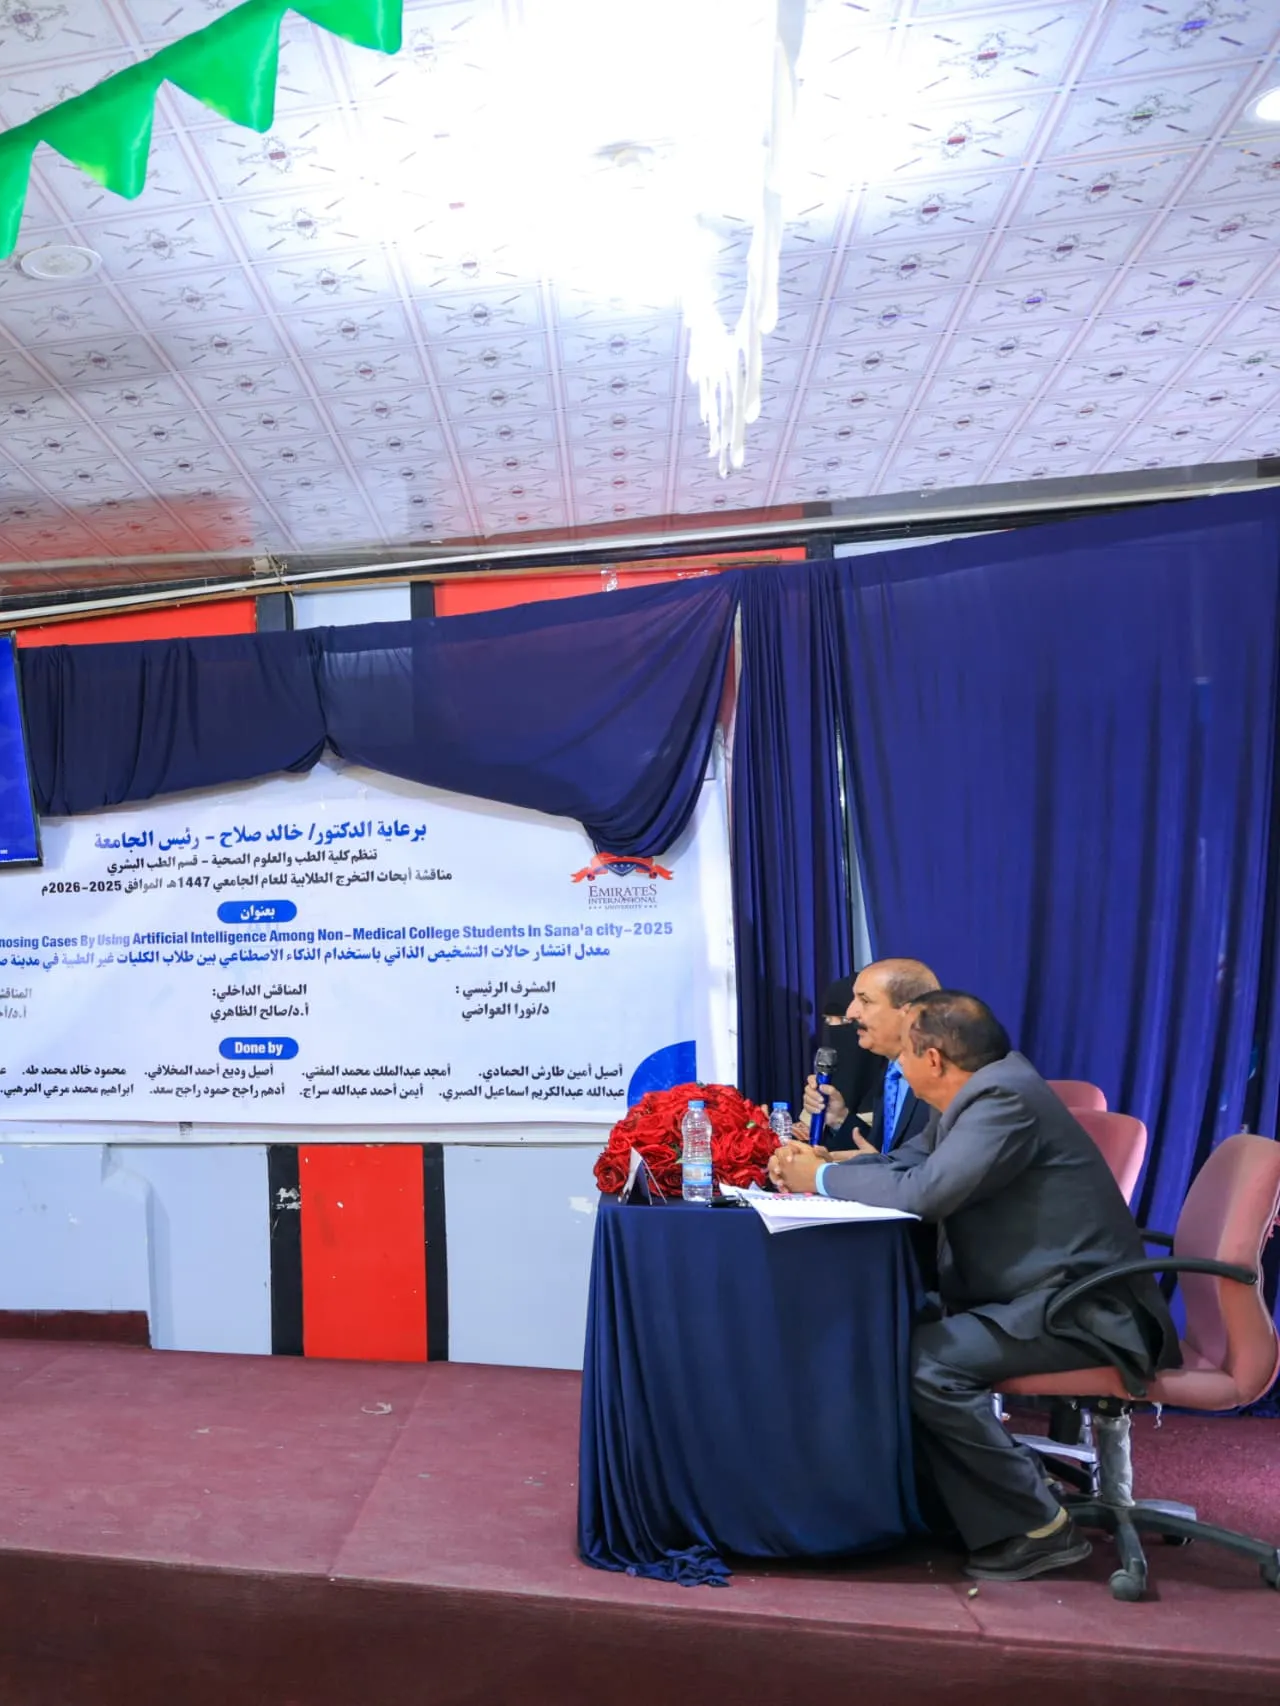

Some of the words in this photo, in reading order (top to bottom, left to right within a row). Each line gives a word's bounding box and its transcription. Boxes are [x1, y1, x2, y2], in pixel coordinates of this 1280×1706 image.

[220, 824, 261, 848] صلاح
[266, 823, 303, 841] خالد
[309, 820, 372, 845] الدكتور/
[376, 819, 426, 842] برعاية
[95, 829, 154, 853] الجامعة
[159, 827, 200, 851] رئيس
[147, 856, 176, 871] الطب
[178, 854, 198, 870] قسم
[211, 853, 251, 868] الصحية
[253, 851, 292, 867] والعلوم
[295, 850, 326, 866] الطب
[328, 849, 350, 864] كلية
[351, 848, 378, 864] تنظم
[107, 857, 144, 876] البشري
[415, 868, 453, 881] مناقشة
[213, 874, 259, 892] الجامعي
[261, 873, 288, 889] للعام
[290, 871, 333, 887] الطلابية
[335, 870, 375, 887] التخرج
[377, 866, 412, 885] أبحاث
[124, 878, 163, 894] الموافق
[588, 883, 657, 898] EMIRATES
[240, 904, 276, 920] بعنوان
[42, 935, 77, 948] Cases
[81, 934, 95, 949] By
[98, 933, 130, 948] Using
[132, 931, 188, 945] Artificial
[191, 931, 266, 945] Intelligence
[270, 929, 315, 944] Among
[409, 926, 459, 941] College
[463, 925, 525, 939] Students
[528, 924, 542, 937] In
[544, 923, 593, 937] Sana'a
[117, 950, 159, 967] الكليات
[163, 950, 193, 966] طلاب
[218, 948, 283, 968] الاصطناعي
[287, 947, 321, 961] الذكاء
[324, 946, 381, 964] باستخدام
[384, 945, 425, 966] الذاتي
[427, 944, 488, 962] التشخيص
[491, 944, 529, 957] حالات
[532, 943, 571, 961] انتشار
[575, 943, 610, 960] معدل
[10, 953, 40, 970] مدينة
[43, 952, 59, 972] في
[62, 951, 95, 968] الطبية
[97, 952, 114, 968] غير
[197, 952, 216, 966] بين
[263, 983, 307, 999] المناقش
[463, 980, 508, 1000] الرئيسي
[510, 980, 556, 998] المشرف
[210, 1004, 257, 1023] الظاهري
[462, 1002, 511, 1022] العواضي
[234, 1041, 266, 1054] Done
[267, 1041, 284, 1056] by
[41, 1066, 68, 1075] محمد
[70, 1064, 92, 1075] خالد
[94, 1066, 127, 1078] محمود
[194, 1062, 220, 1076] أحمد
[222, 1066, 246, 1080] وديع
[248, 1063, 274, 1079] أصيل
[341, 1066, 370, 1077] محمد
[373, 1065, 421, 1079] عبدالملك
[423, 1063, 451, 1080] أمجد
[531, 1065, 565, 1080] طارش
[567, 1062, 592, 1080] أمين
[594, 1062, 623, 1080] أصيل
[43, 1084, 70, 1098] مرعي
[72, 1085, 98, 1095] محمد
[100, 1083, 134, 1097] ابراهيم
[176, 1084, 200, 1098] راجح
[203, 1086, 230, 1099] حمود
[232, 1084, 259, 1099] راجح
[260, 1082, 285, 1098] أدهم
[331, 1084, 367, 1099] عبدالله
[370, 1082, 397, 1096] أحمد
[399, 1082, 424, 1099] أيمن
[484, 1085, 529, 1099] اسماعيل
[531, 1085, 583, 1101] عبدالكريم
[586, 1085, 625, 1100] عبدالله
